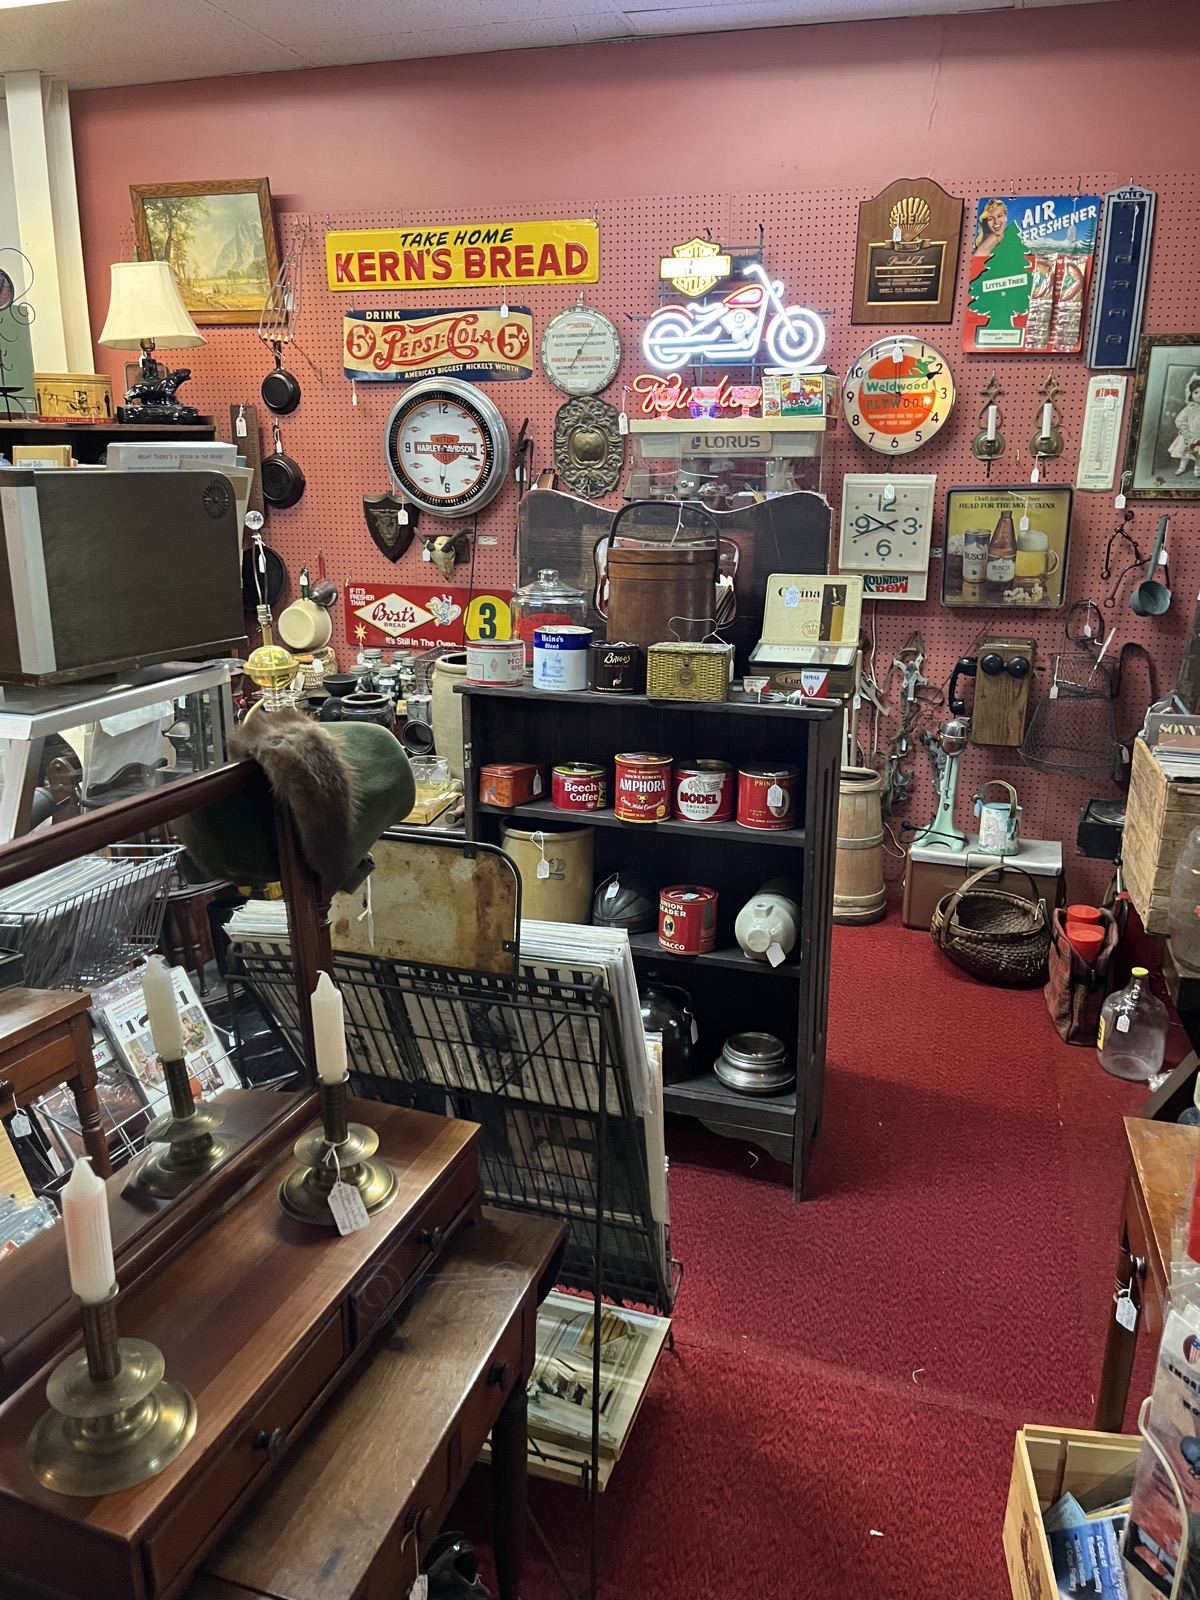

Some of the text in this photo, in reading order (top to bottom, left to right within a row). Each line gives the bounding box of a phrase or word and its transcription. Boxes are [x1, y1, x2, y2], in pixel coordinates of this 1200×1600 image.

[1119, 191, 1143, 200] YALE
[893, 214, 925, 224] SHELL
[1022, 200, 1057, 228] AIR
[1022, 205, 1097, 243] FRESHENER
[400, 227, 515, 248] TAKE HOME
[335, 242, 589, 283] KERN'S BREAD
[985, 277, 1026, 290] LITTLE TREE
[366, 310, 400, 320] DRINK
[350, 325, 374, 357] 5¢
[506, 323, 529, 357] 5¢
[404, 362, 519, 379] AMERICA'S BIGGEST NICKEL'S WORTH
[851, 367, 864, 379] 10
[936, 363, 943, 374] 2
[866, 380, 929, 392] Weldwood
[846, 391, 854, 403] 9
[940, 388, 947, 400] 3
[438, 403, 449, 414] 12
[852, 414, 860, 426] 8
[931, 412, 939, 423] 4
[868, 432, 875, 443] 7
[915, 430, 922, 442] 5
[405, 442, 411, 453] 9
[416, 443, 475, 454] HARLEY-DAVIDSON
[705, 436, 760, 449] LORUS
[891, 437, 898, 448] 6
[444, 482, 451, 494] 6
[878, 494, 897, 512] 12
[855, 516, 871, 534] 9
[903, 517, 918, 535] 3
[876, 539, 892, 556] 6
[372, 602, 418, 623] Bost's
[478, 602, 497, 640] 3
[385, 637, 396, 645] It's
[397, 637, 410, 646] Still
[419, 639, 435, 647] The
[541, 634, 564, 643] Heine's
[620, 778, 666, 792] AMPHORA
[570, 794, 598, 802] Coffee
[680, 792, 718, 804] MODEL
